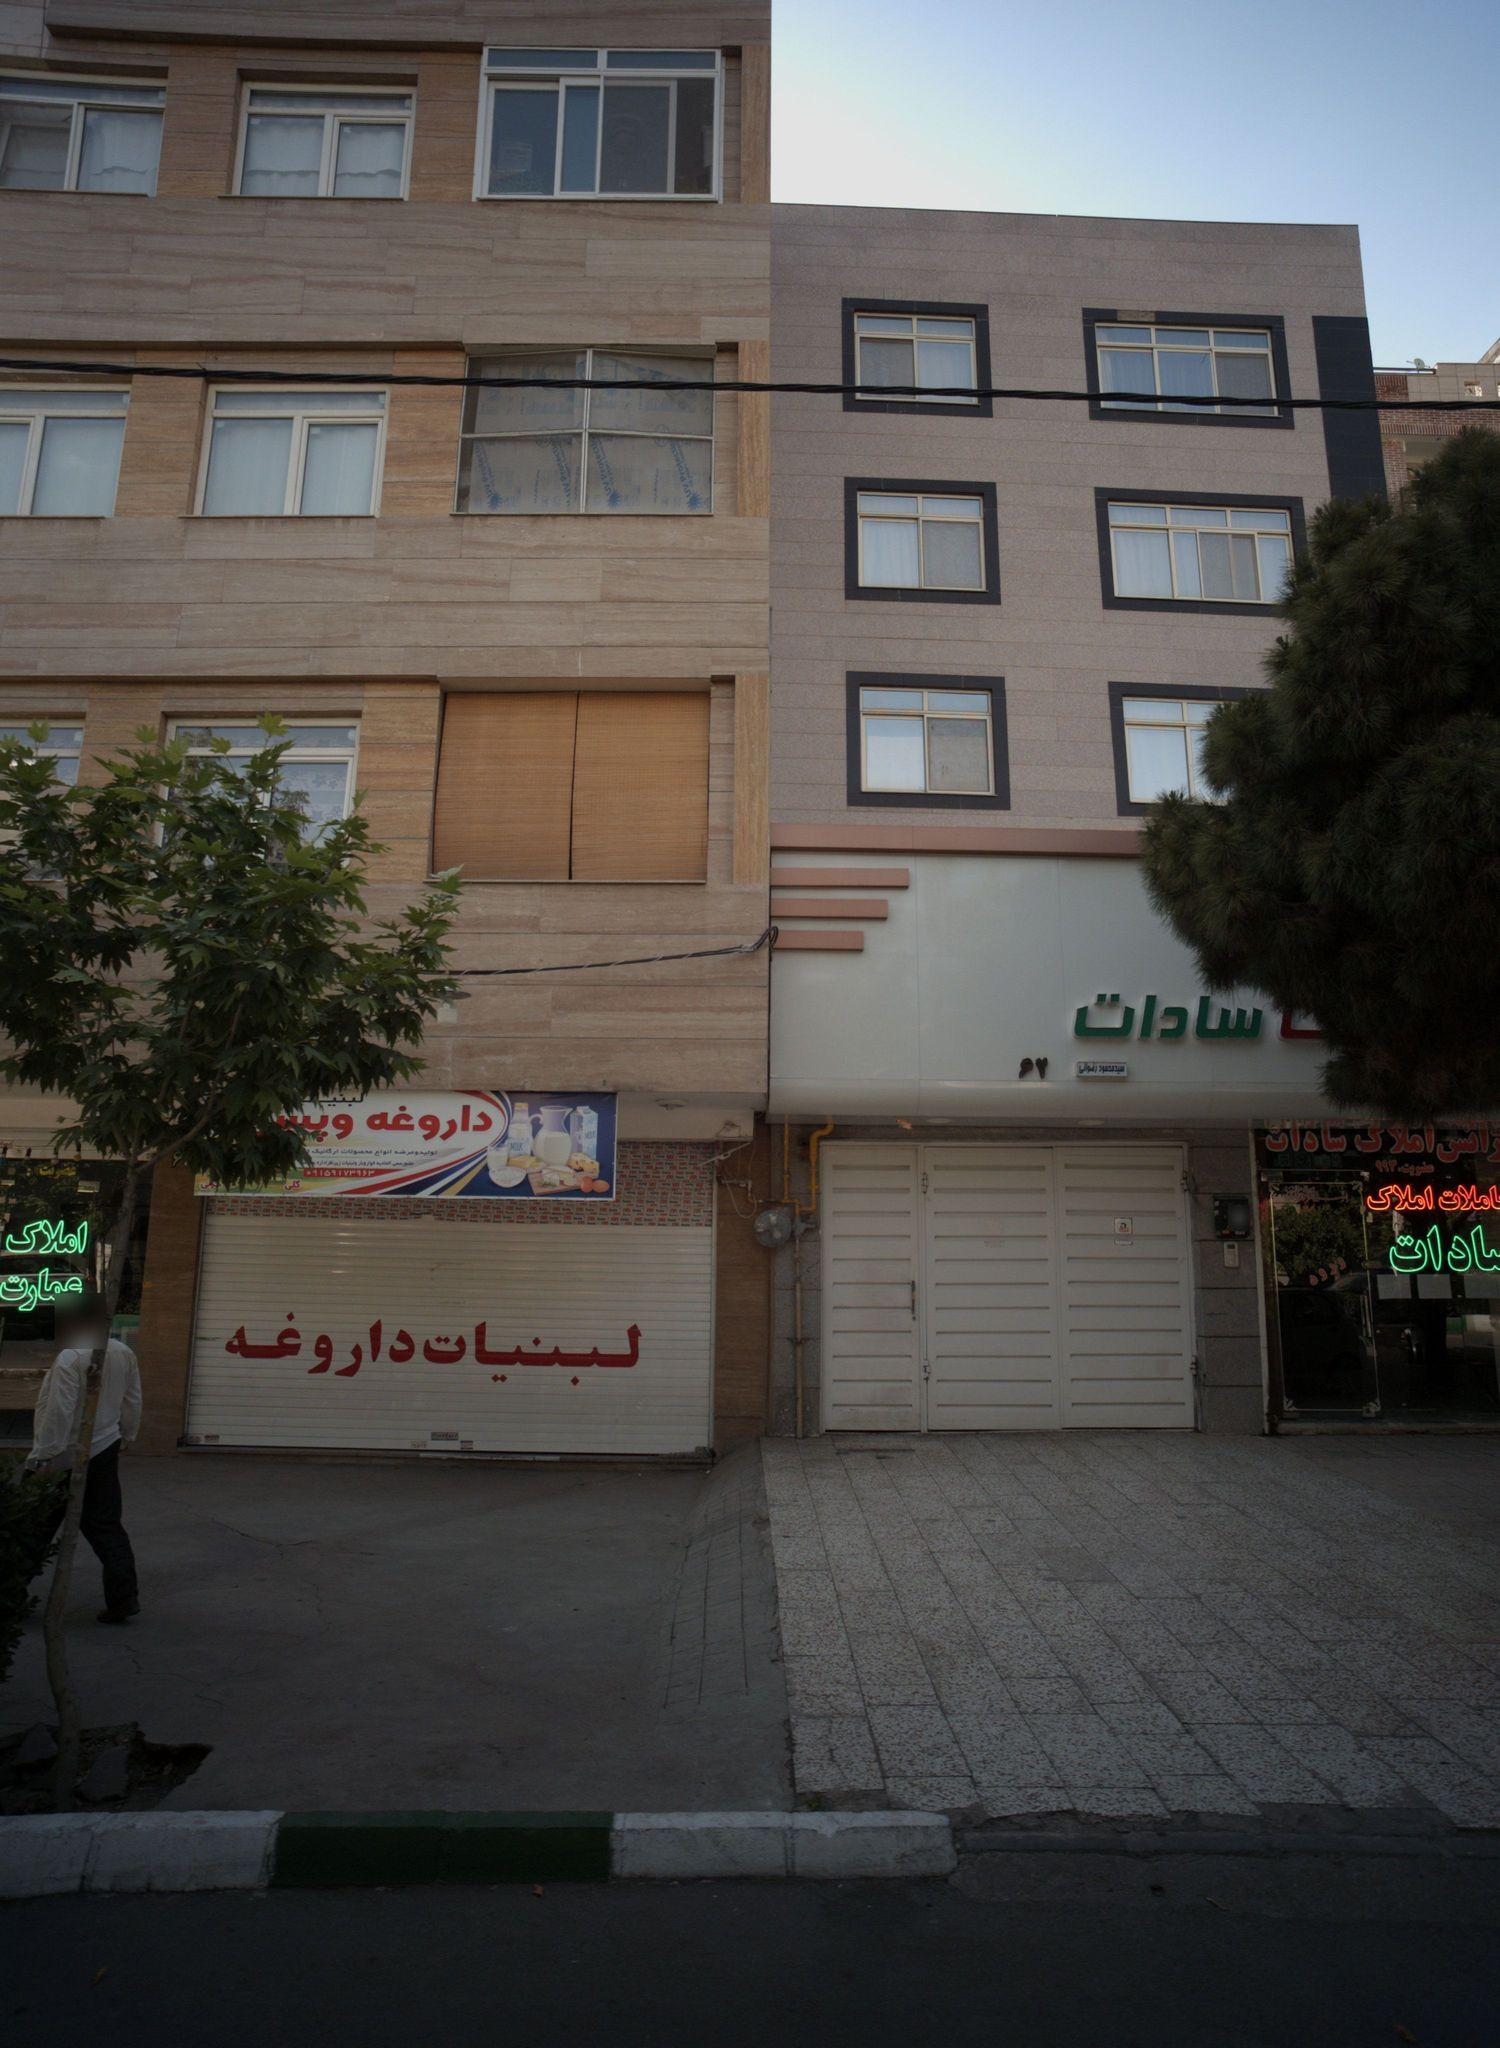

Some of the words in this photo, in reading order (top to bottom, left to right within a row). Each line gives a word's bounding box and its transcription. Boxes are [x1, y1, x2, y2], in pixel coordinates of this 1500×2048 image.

[1076, 995, 1260, 1038] سادات
[366, 1105, 493, 1141] داروغه
[1265, 1121, 1347, 1152] سادات
[1365, 1184, 1435, 1211] املاک
[1437, 1184, 1500, 1212] املات
[4, 1218, 89, 1254] املاک
[0, 1267, 84, 1312] عمارت
[224, 1312, 415, 1377] داروغه
[424, 1321, 641, 1385] لبنیات
